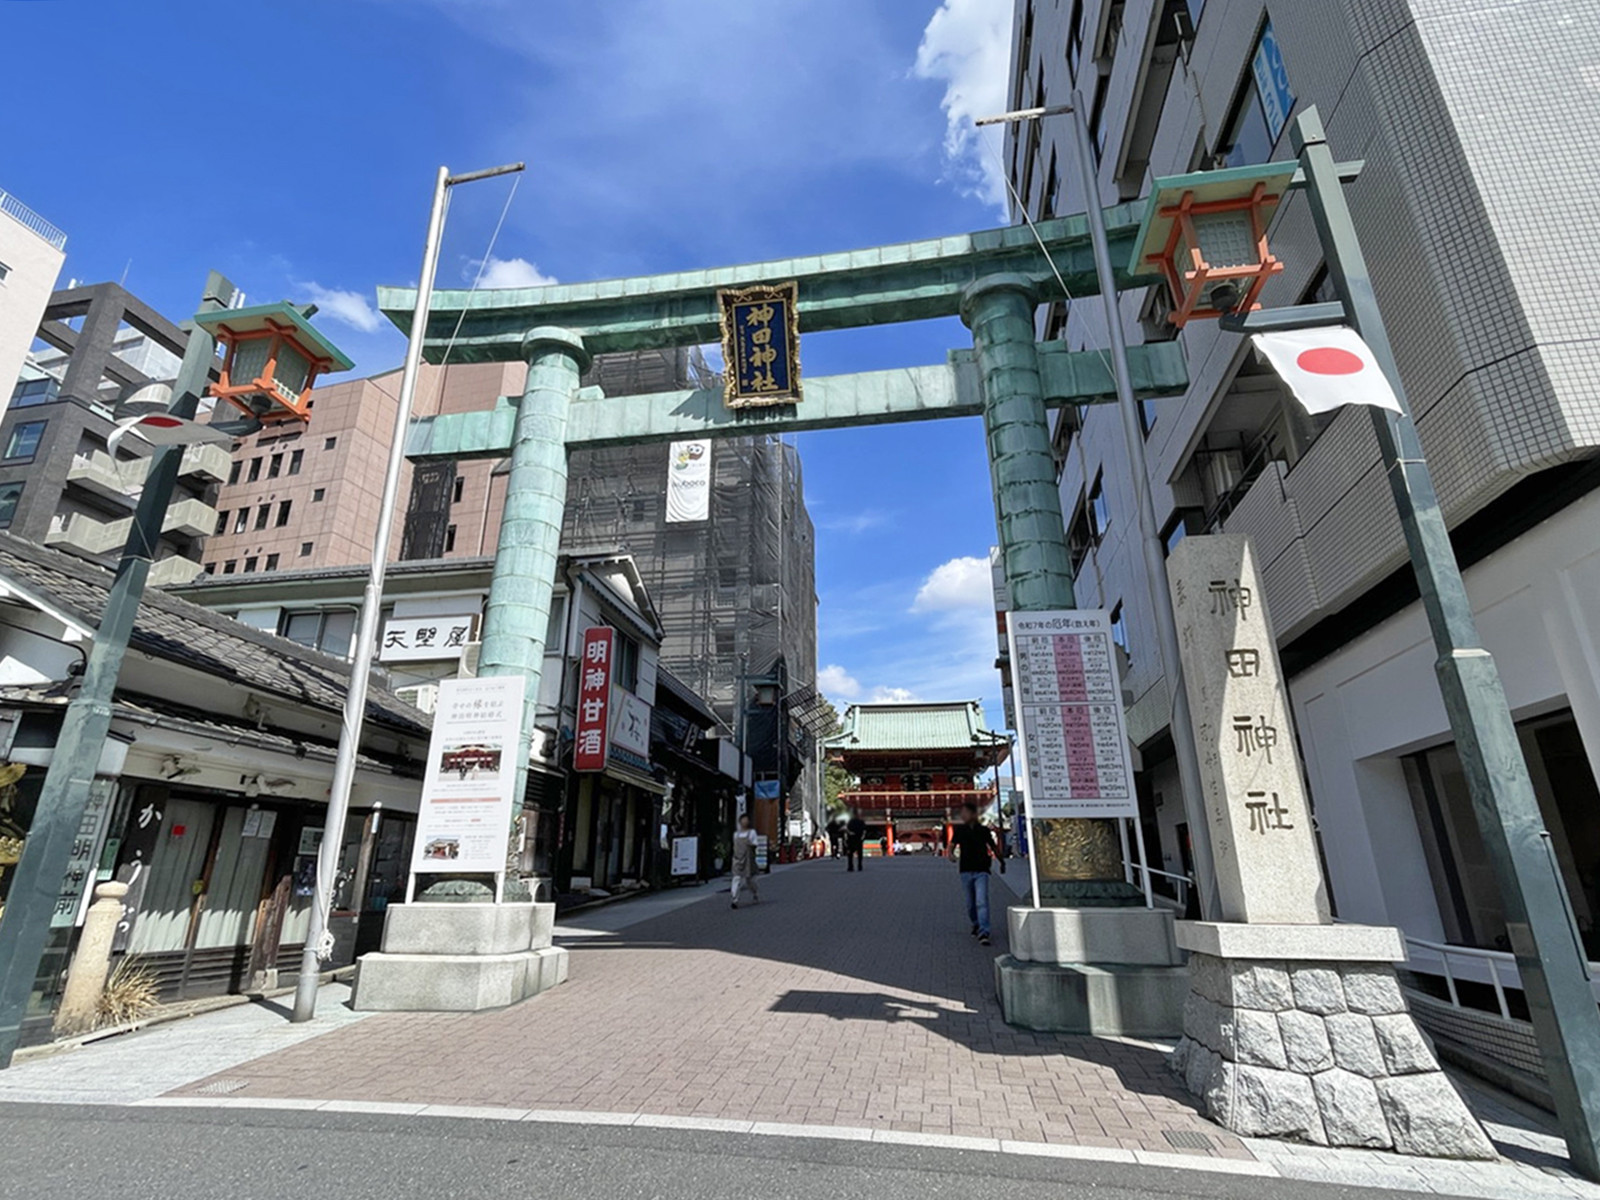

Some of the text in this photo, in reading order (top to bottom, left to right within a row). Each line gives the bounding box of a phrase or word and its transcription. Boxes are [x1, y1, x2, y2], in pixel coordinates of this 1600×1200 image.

[746, 303, 779, 392] 神田神社
[578, 639, 608, 755] 明神甘酒
[1208, 579, 1293, 835] 神田神社
